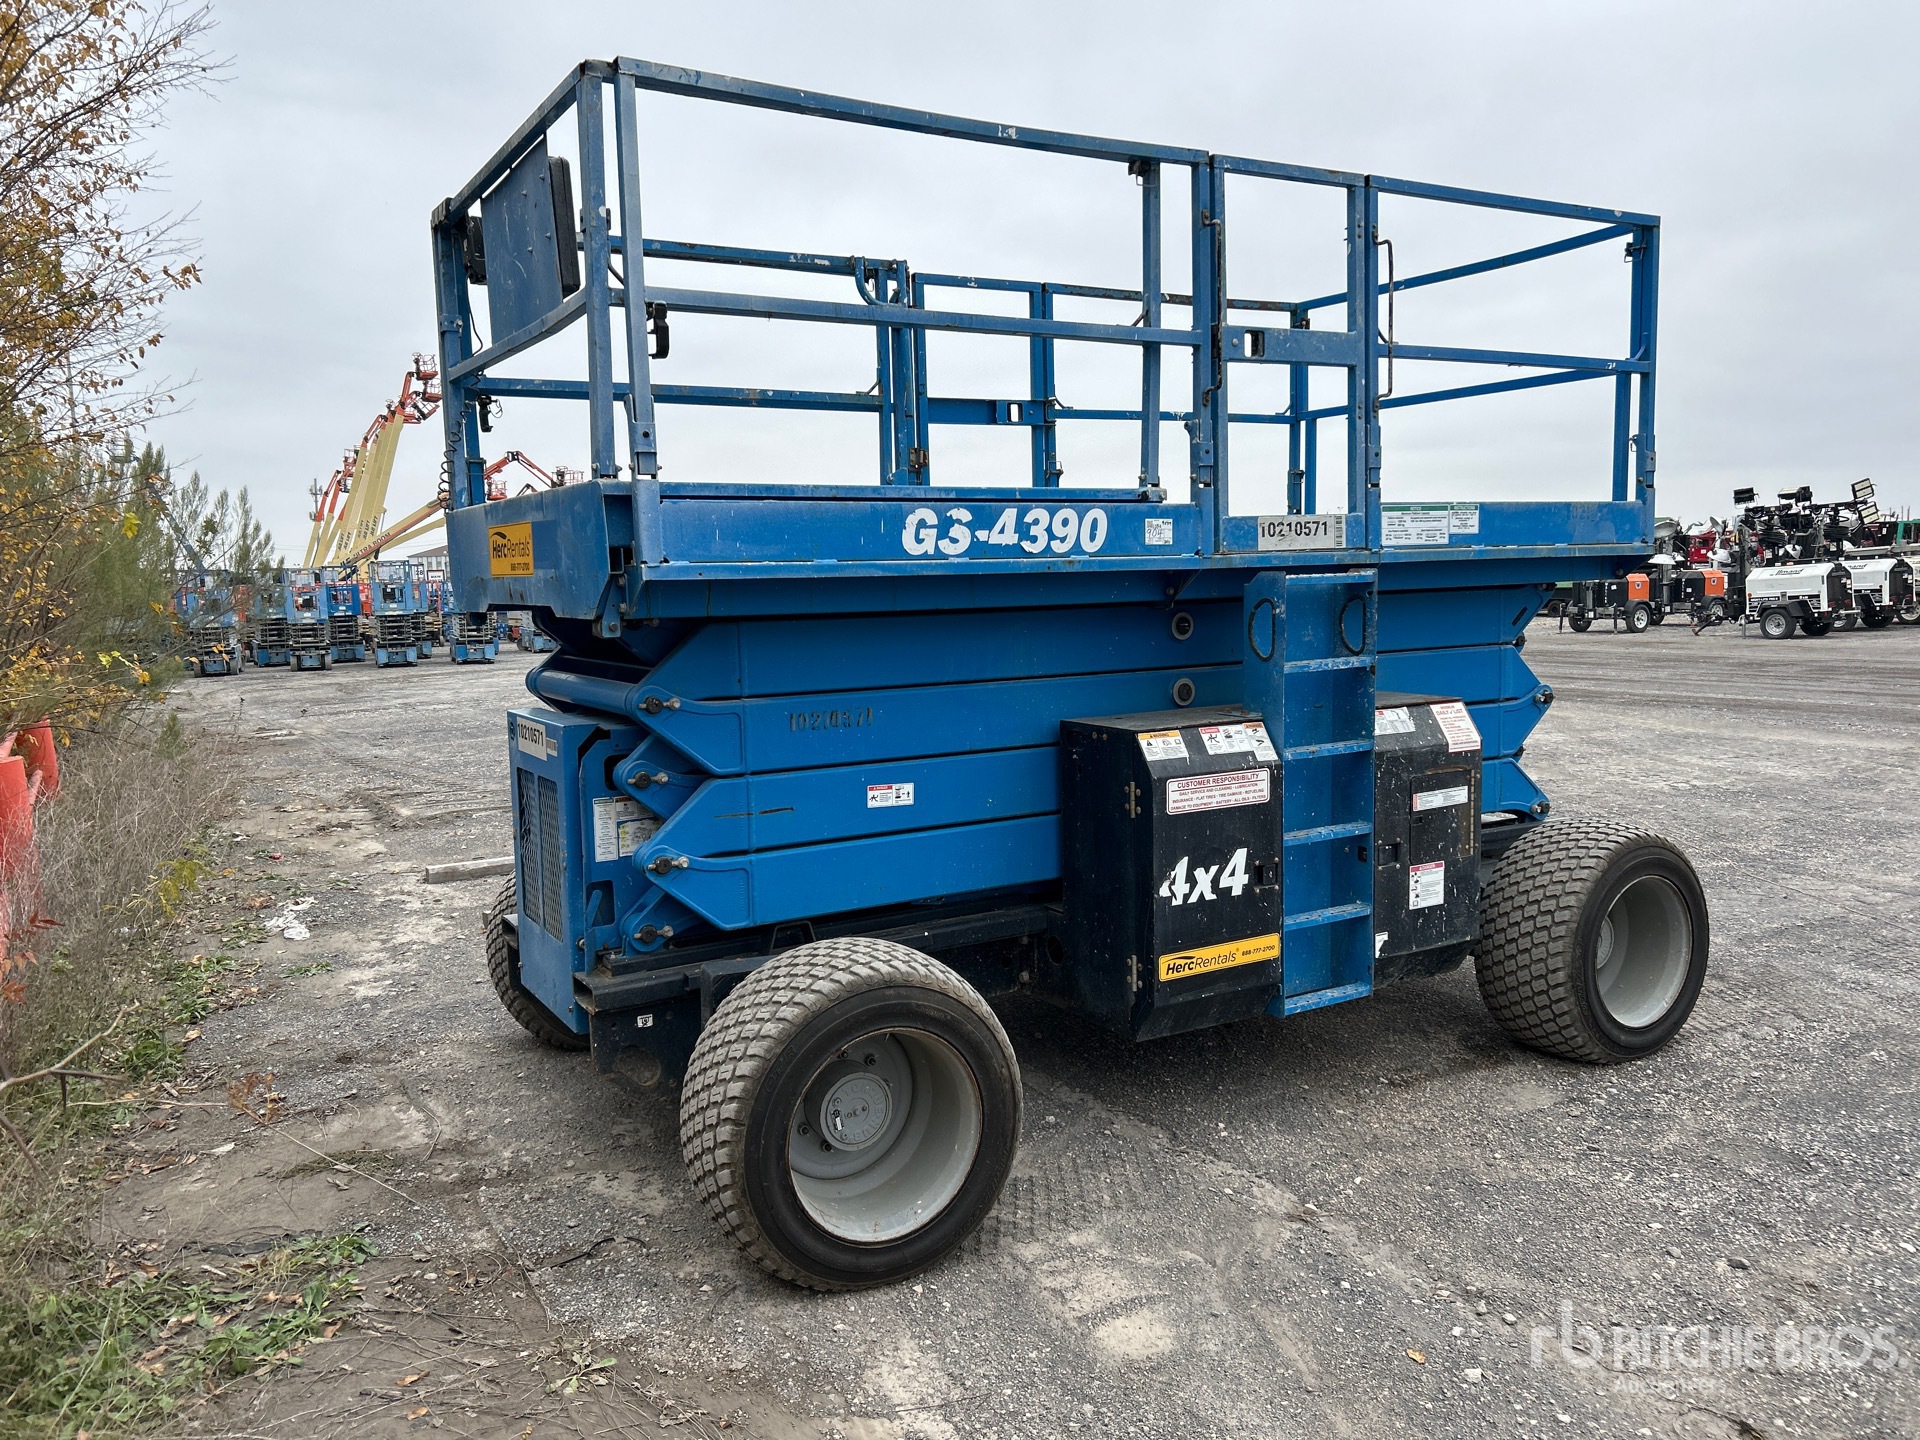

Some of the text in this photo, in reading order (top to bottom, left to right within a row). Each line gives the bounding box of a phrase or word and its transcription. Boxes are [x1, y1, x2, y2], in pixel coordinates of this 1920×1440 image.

[1259, 520, 1329, 539] 10210571
[492, 536, 530, 559] HercRentals
[518, 723, 544, 746] 10210571
[1177, 773, 1260, 789] CUSTOMER RESPONSIBILITY
[1159, 848, 1249, 906] 4x4
[1166, 945, 1276, 976] HercRentals 888-777-2700
